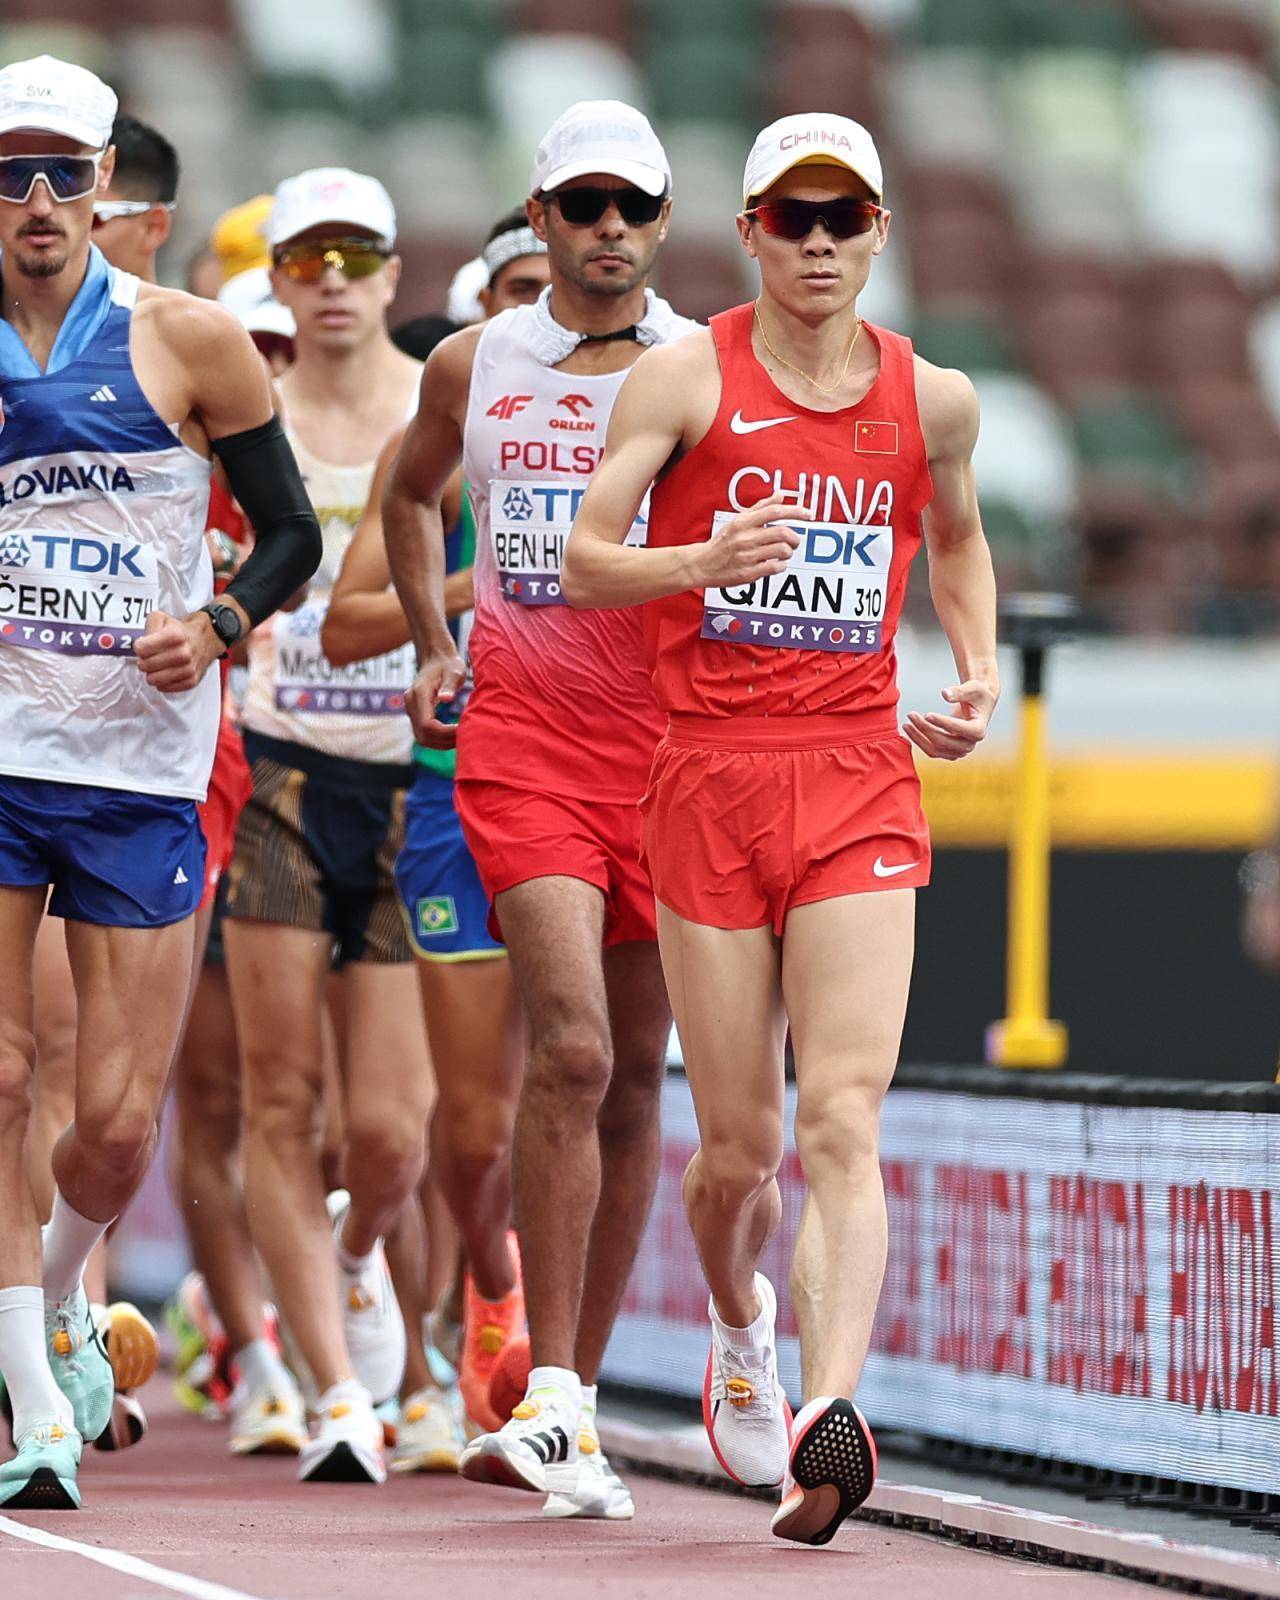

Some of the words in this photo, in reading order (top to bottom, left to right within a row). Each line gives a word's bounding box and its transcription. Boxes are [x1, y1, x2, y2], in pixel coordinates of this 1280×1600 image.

[26, 85, 55, 97] SVK
[780, 131, 851, 151] CHINA
[486, 395, 535, 420] 4F
[549, 419, 595, 431] ORLEN
[501, 441, 605, 474] POLS
[728, 466, 893, 525] CHINA
[32, 535, 146, 577] TDK
[496, 533, 536, 568] BEN
[720, 574, 843, 613] QIAN
[854, 588, 882, 617] 310
[22, 626, 141, 649] TOKYO2
[1168, 1180, 1278, 1416] HONDA
